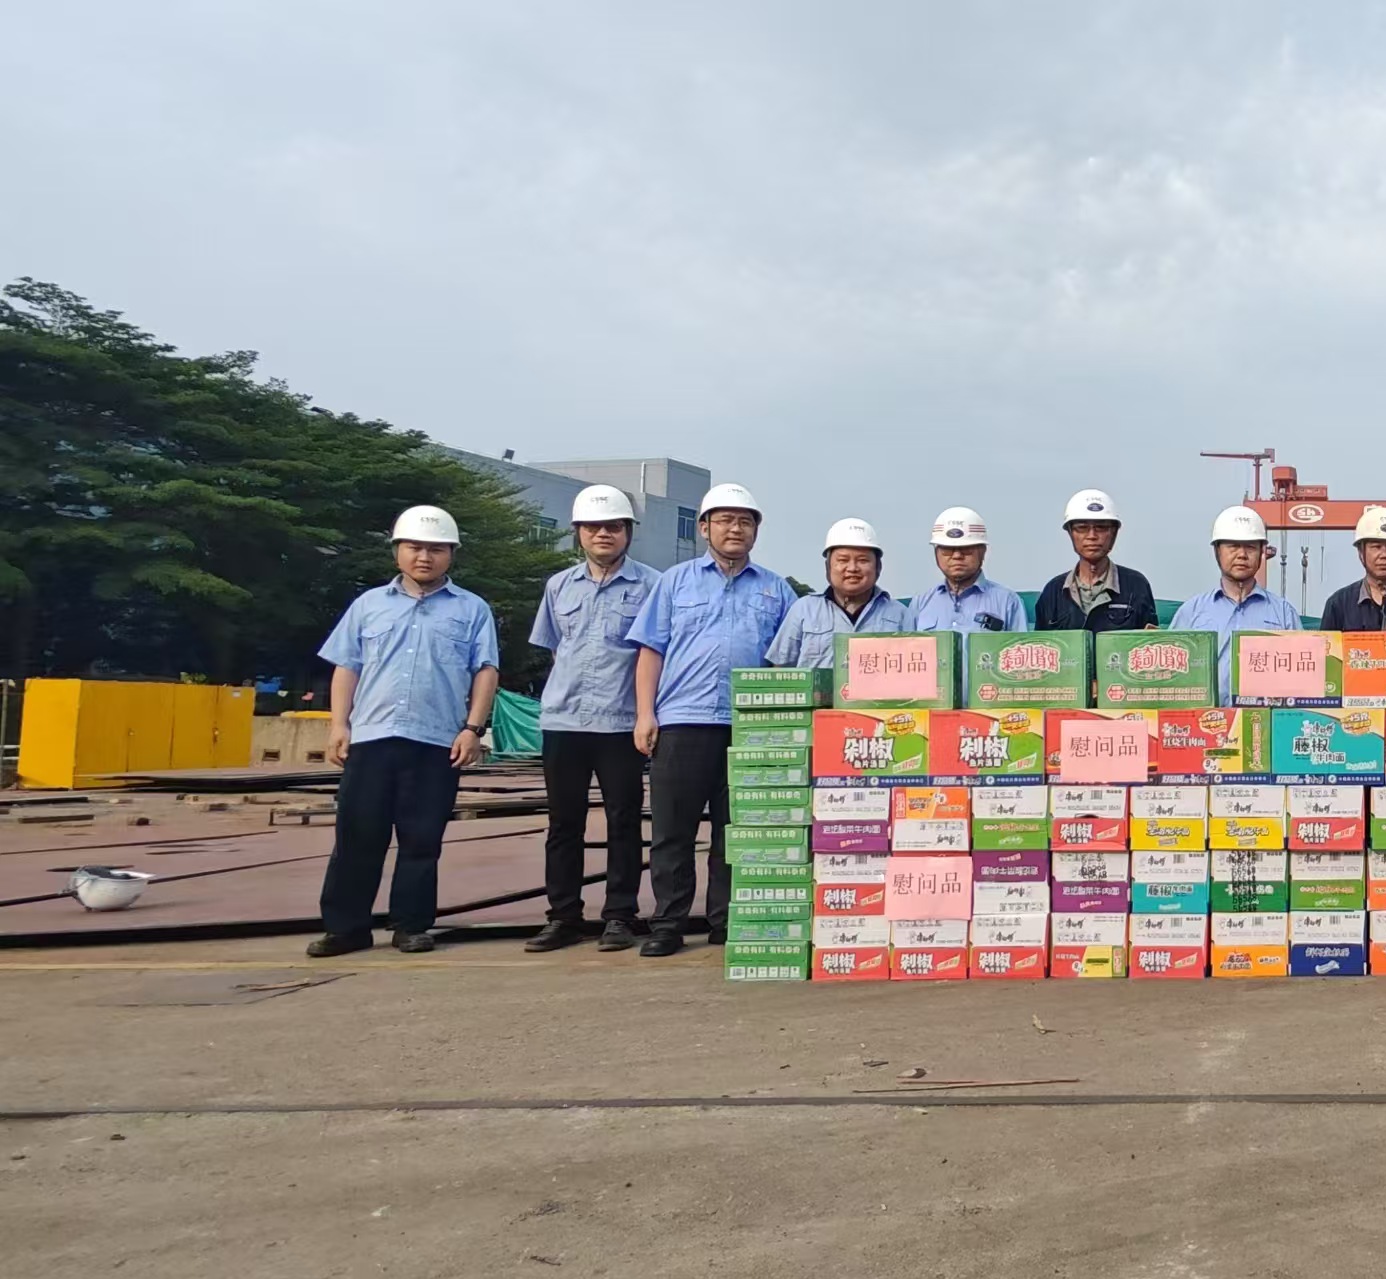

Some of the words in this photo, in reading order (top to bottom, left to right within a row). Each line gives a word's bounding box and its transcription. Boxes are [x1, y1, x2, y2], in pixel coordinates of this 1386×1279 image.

[858, 651, 928, 676] 慰问品
[1248, 650, 1317, 673] 慰问品
[844, 737, 894, 762] 剁椒
[960, 736, 1009, 760] 剁椒
[1070, 734, 1139, 758] 慰问品
[1294, 738, 1329, 753] 藤椒
[893, 871, 962, 895] 慰问品
